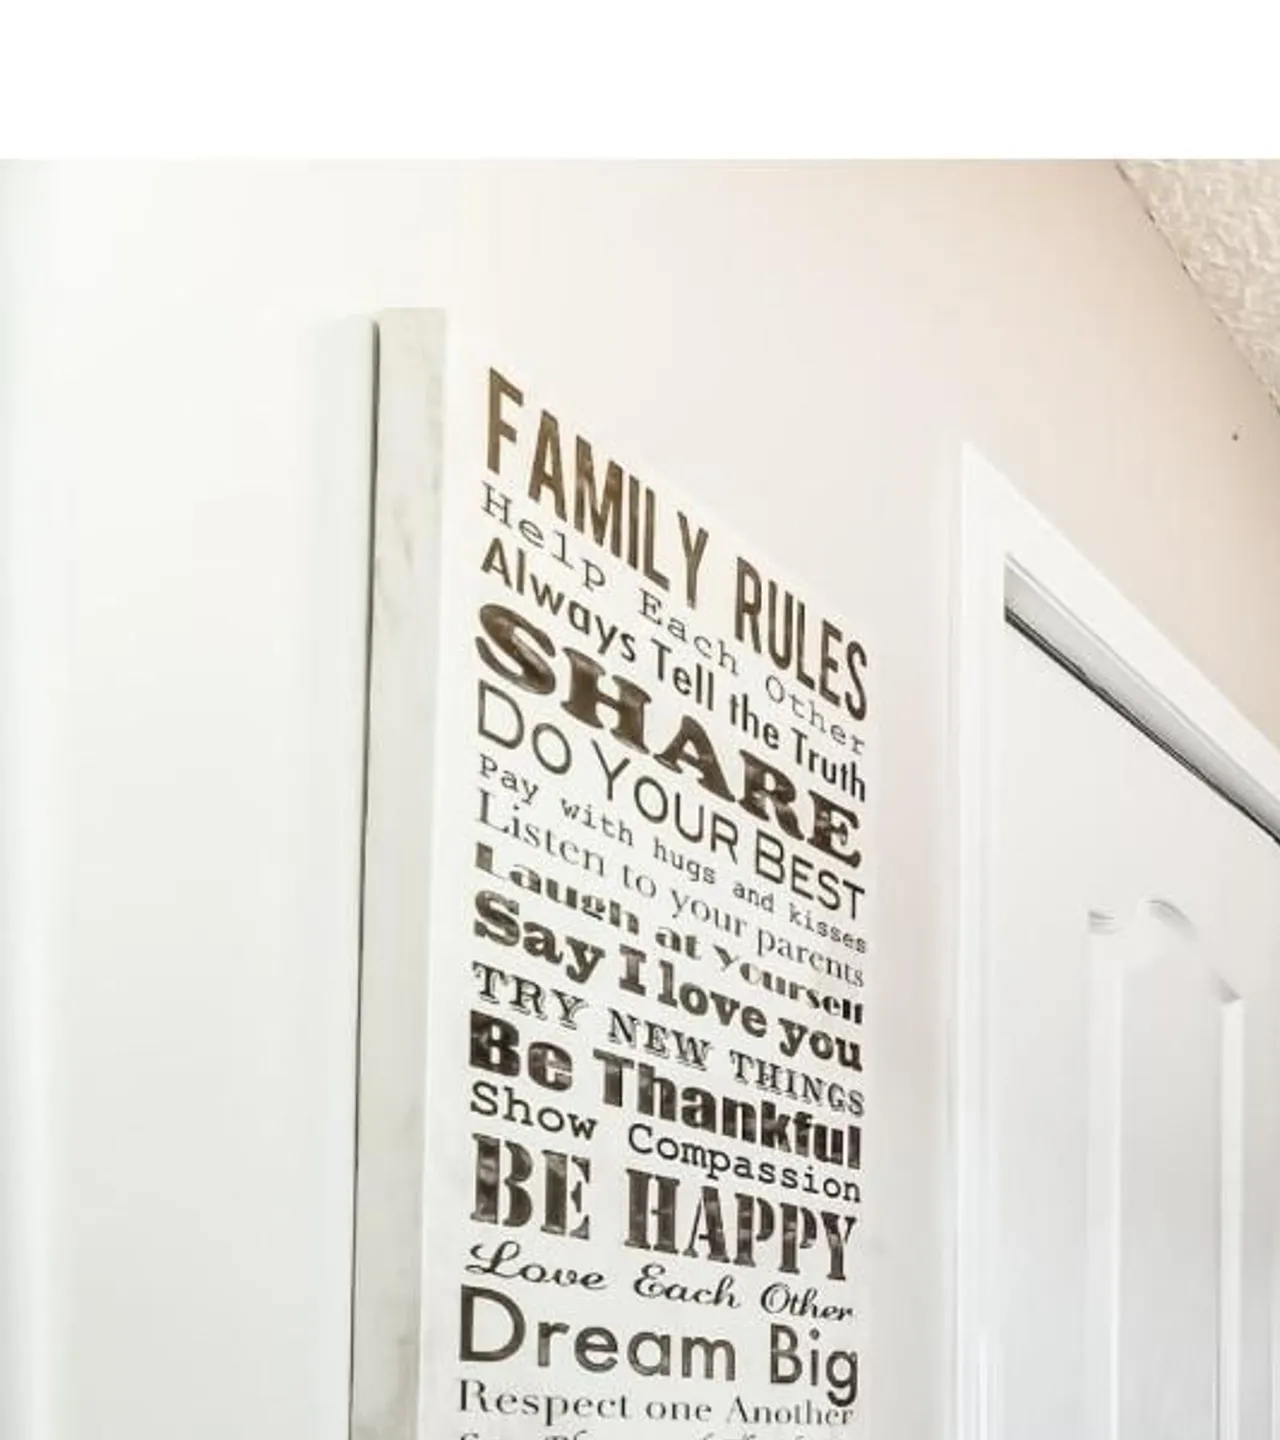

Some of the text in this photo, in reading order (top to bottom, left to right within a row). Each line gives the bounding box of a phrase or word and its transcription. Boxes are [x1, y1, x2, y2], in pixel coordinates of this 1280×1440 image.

[481, 480, 866, 757] Help Each Other
[487, 367, 867, 723] FAMILY RULES
[475, 603, 862, 870] SHARE
[480, 535, 867, 805] Always Tell the Truth
[474, 788, 866, 990] Listen to your parents
[474, 841, 640, 936] Laugh
[654, 926, 703, 962] at
[479, 752, 867, 956] Pay with hugs and kisses
[471, 959, 866, 1118] TRY NEW THINGS
[473, 889, 865, 1073] Say I love you
[468, 1009, 863, 1171] Be Thankful
[469, 1079, 863, 1206] Show Compassion
[464, 1239, 855, 1322] Love Each Other
[469, 1132, 860, 1284] BE HAPPY
[457, 1377, 855, 1428] Respect one Another
[458, 1283, 859, 1410] Dream Big
